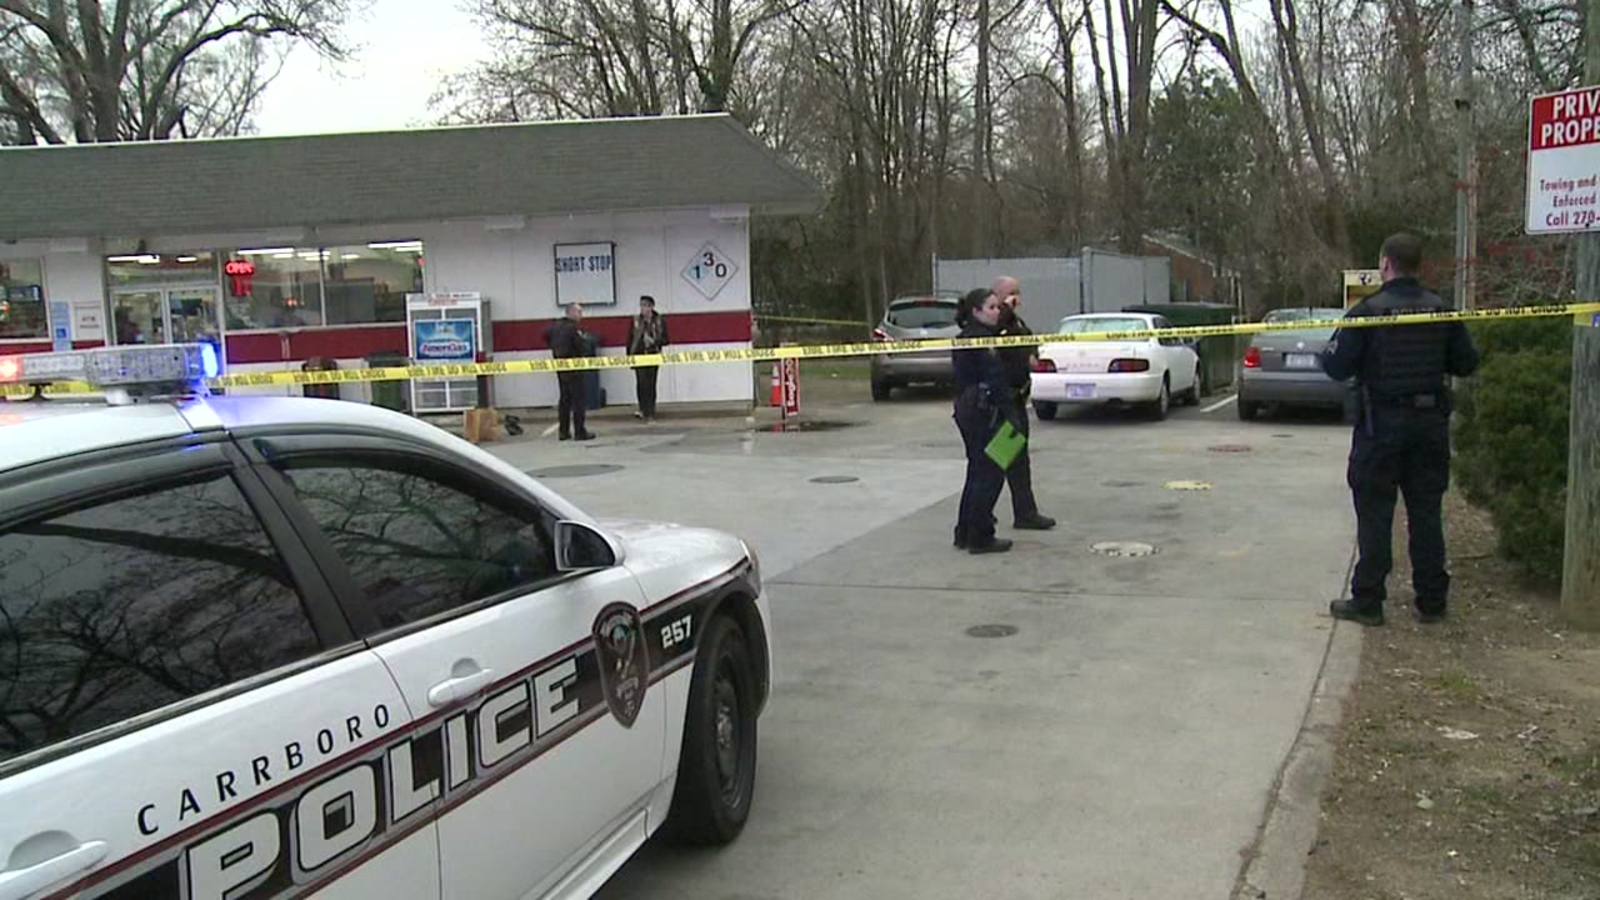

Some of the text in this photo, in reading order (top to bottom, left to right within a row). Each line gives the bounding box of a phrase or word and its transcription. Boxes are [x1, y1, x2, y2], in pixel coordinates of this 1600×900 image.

[1553, 90, 1600, 119] PRIV
[1540, 174, 1596, 192] Towing and
[1553, 194, 1596, 207] Enforced
[1546, 210, 1600, 227] Call 270-
[226, 262, 253, 274] OPEN
[555, 255, 612, 273] SHORT STOP
[703, 251, 715, 268] 3
[693, 264, 702, 281] 1
[714, 263, 727, 278] 0
[422, 341, 467, 353] AmeriGas
[660, 614, 692, 650] 257
[136, 703, 390, 836] CARRBORO
[184, 656, 581, 900] POLICE
